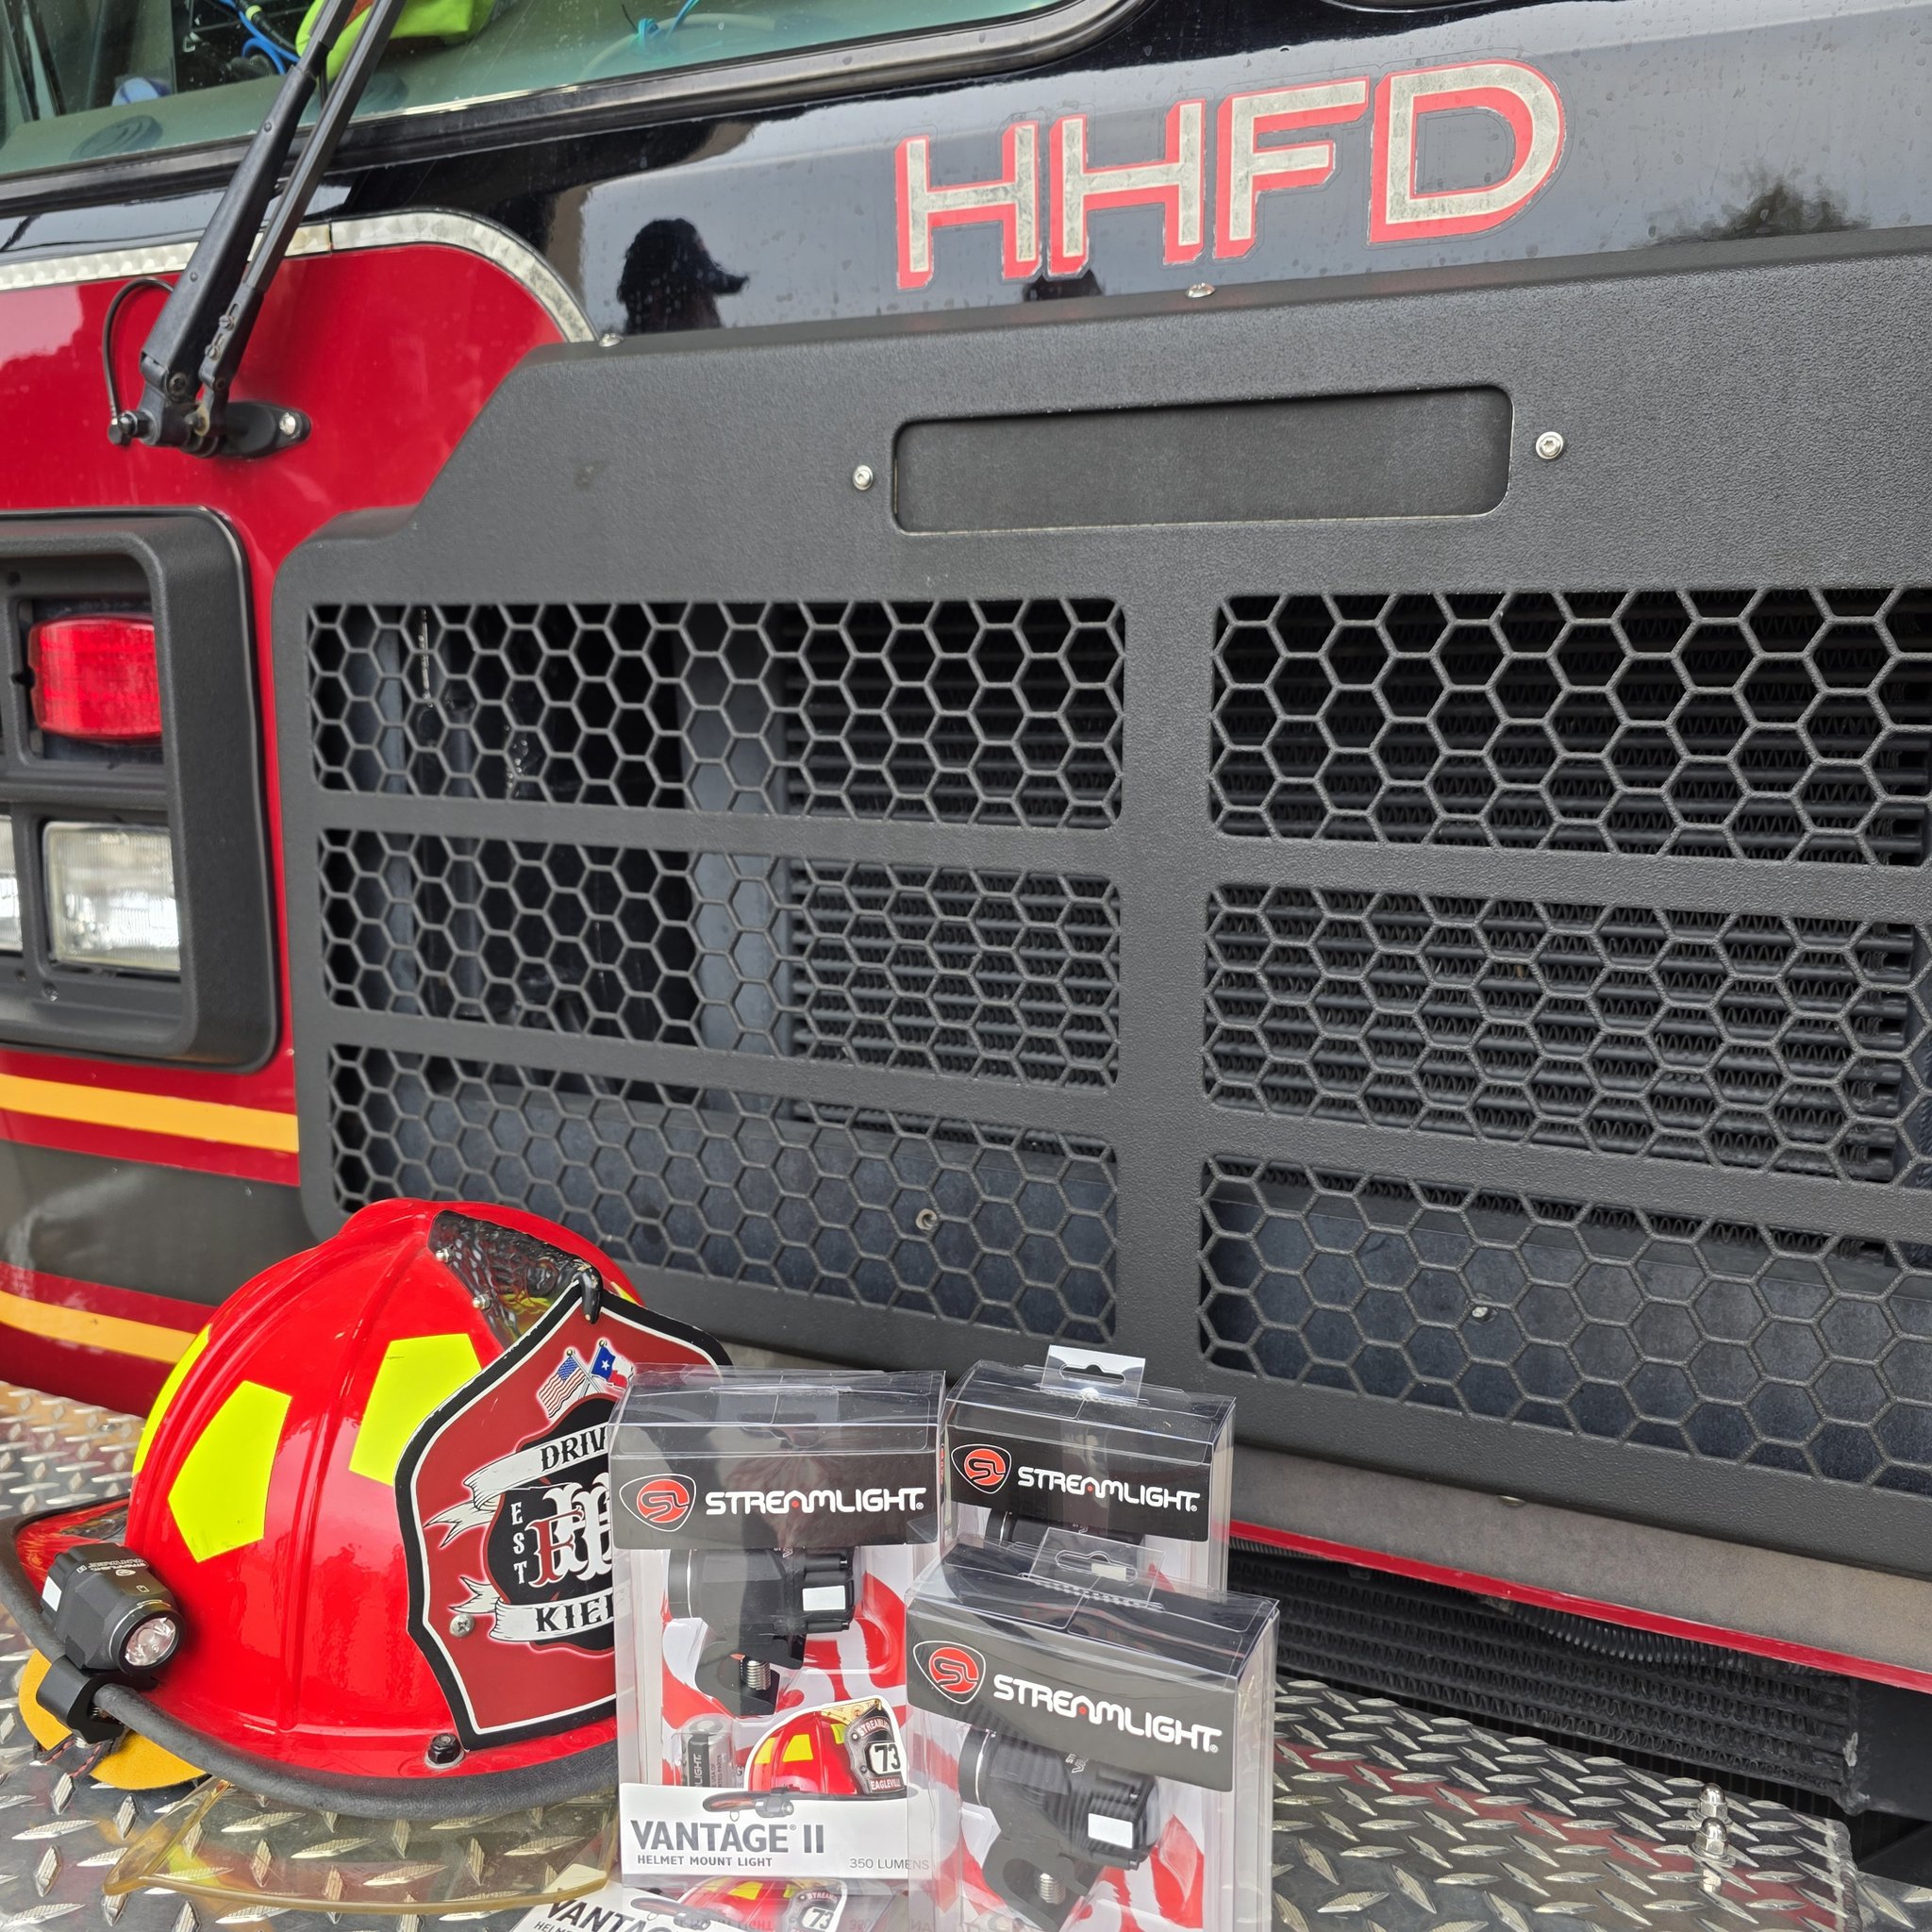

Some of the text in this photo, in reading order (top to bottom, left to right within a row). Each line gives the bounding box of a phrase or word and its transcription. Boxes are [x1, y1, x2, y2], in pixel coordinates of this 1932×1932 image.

[894, 58, 1566, 290] HHFD
[874, 1743, 902, 1773] 73
[804, 1824, 824, 1854] II
[637, 1855, 774, 1868] HELMET MOUNT LIGHT
[848, 1857, 930, 1870] 350 LUMENS
[808, 1907, 835, 1931] 73
